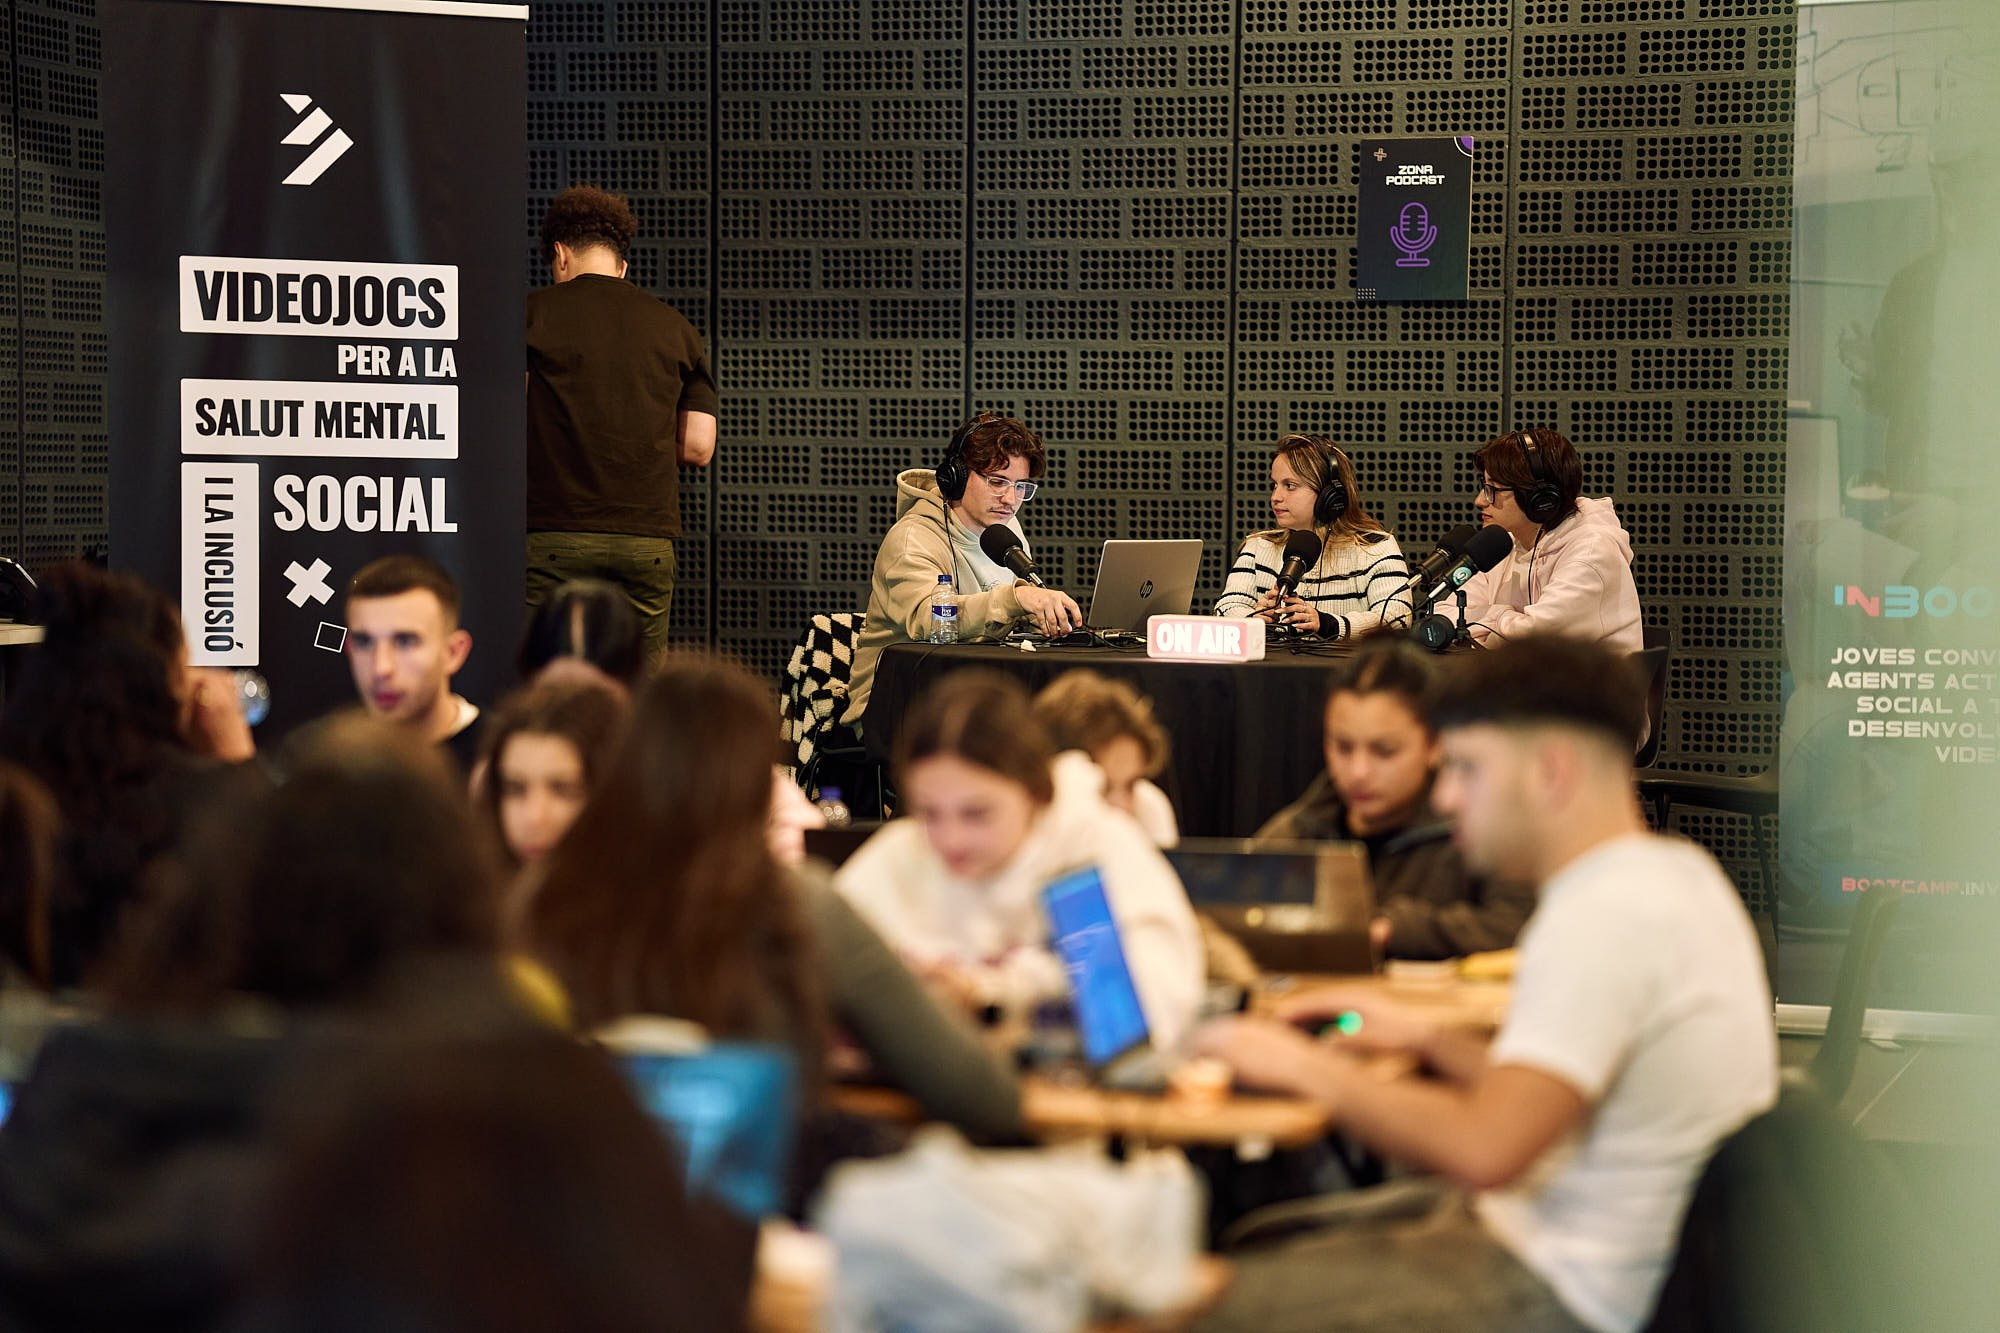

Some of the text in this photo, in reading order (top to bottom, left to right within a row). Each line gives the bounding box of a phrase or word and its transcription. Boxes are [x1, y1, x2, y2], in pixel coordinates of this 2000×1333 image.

[1385, 175, 1446, 186] PODCAST
[1398, 164, 1433, 175] ZONA
[193, 270, 446, 328] VIDEOJOCS
[337, 344, 458, 377] PER A LA
[195, 398, 446, 440] SALUT MENTAL
[204, 494, 234, 523] LA
[273, 474, 458, 533] SOCIAL
[204, 532, 244, 652] INCLUSIÓ
[1156, 622, 1242, 655] ON AIR
[1831, 648, 2000, 666] JOVES CONV
[1827, 671, 2000, 690] AGENTS ACT
[1857, 696, 1953, 713] SOCIAL
[1963, 698, 1979, 714] A
[1849, 720, 2000, 739] DESENVOL
[1935, 746, 2000, 763] VIDE
